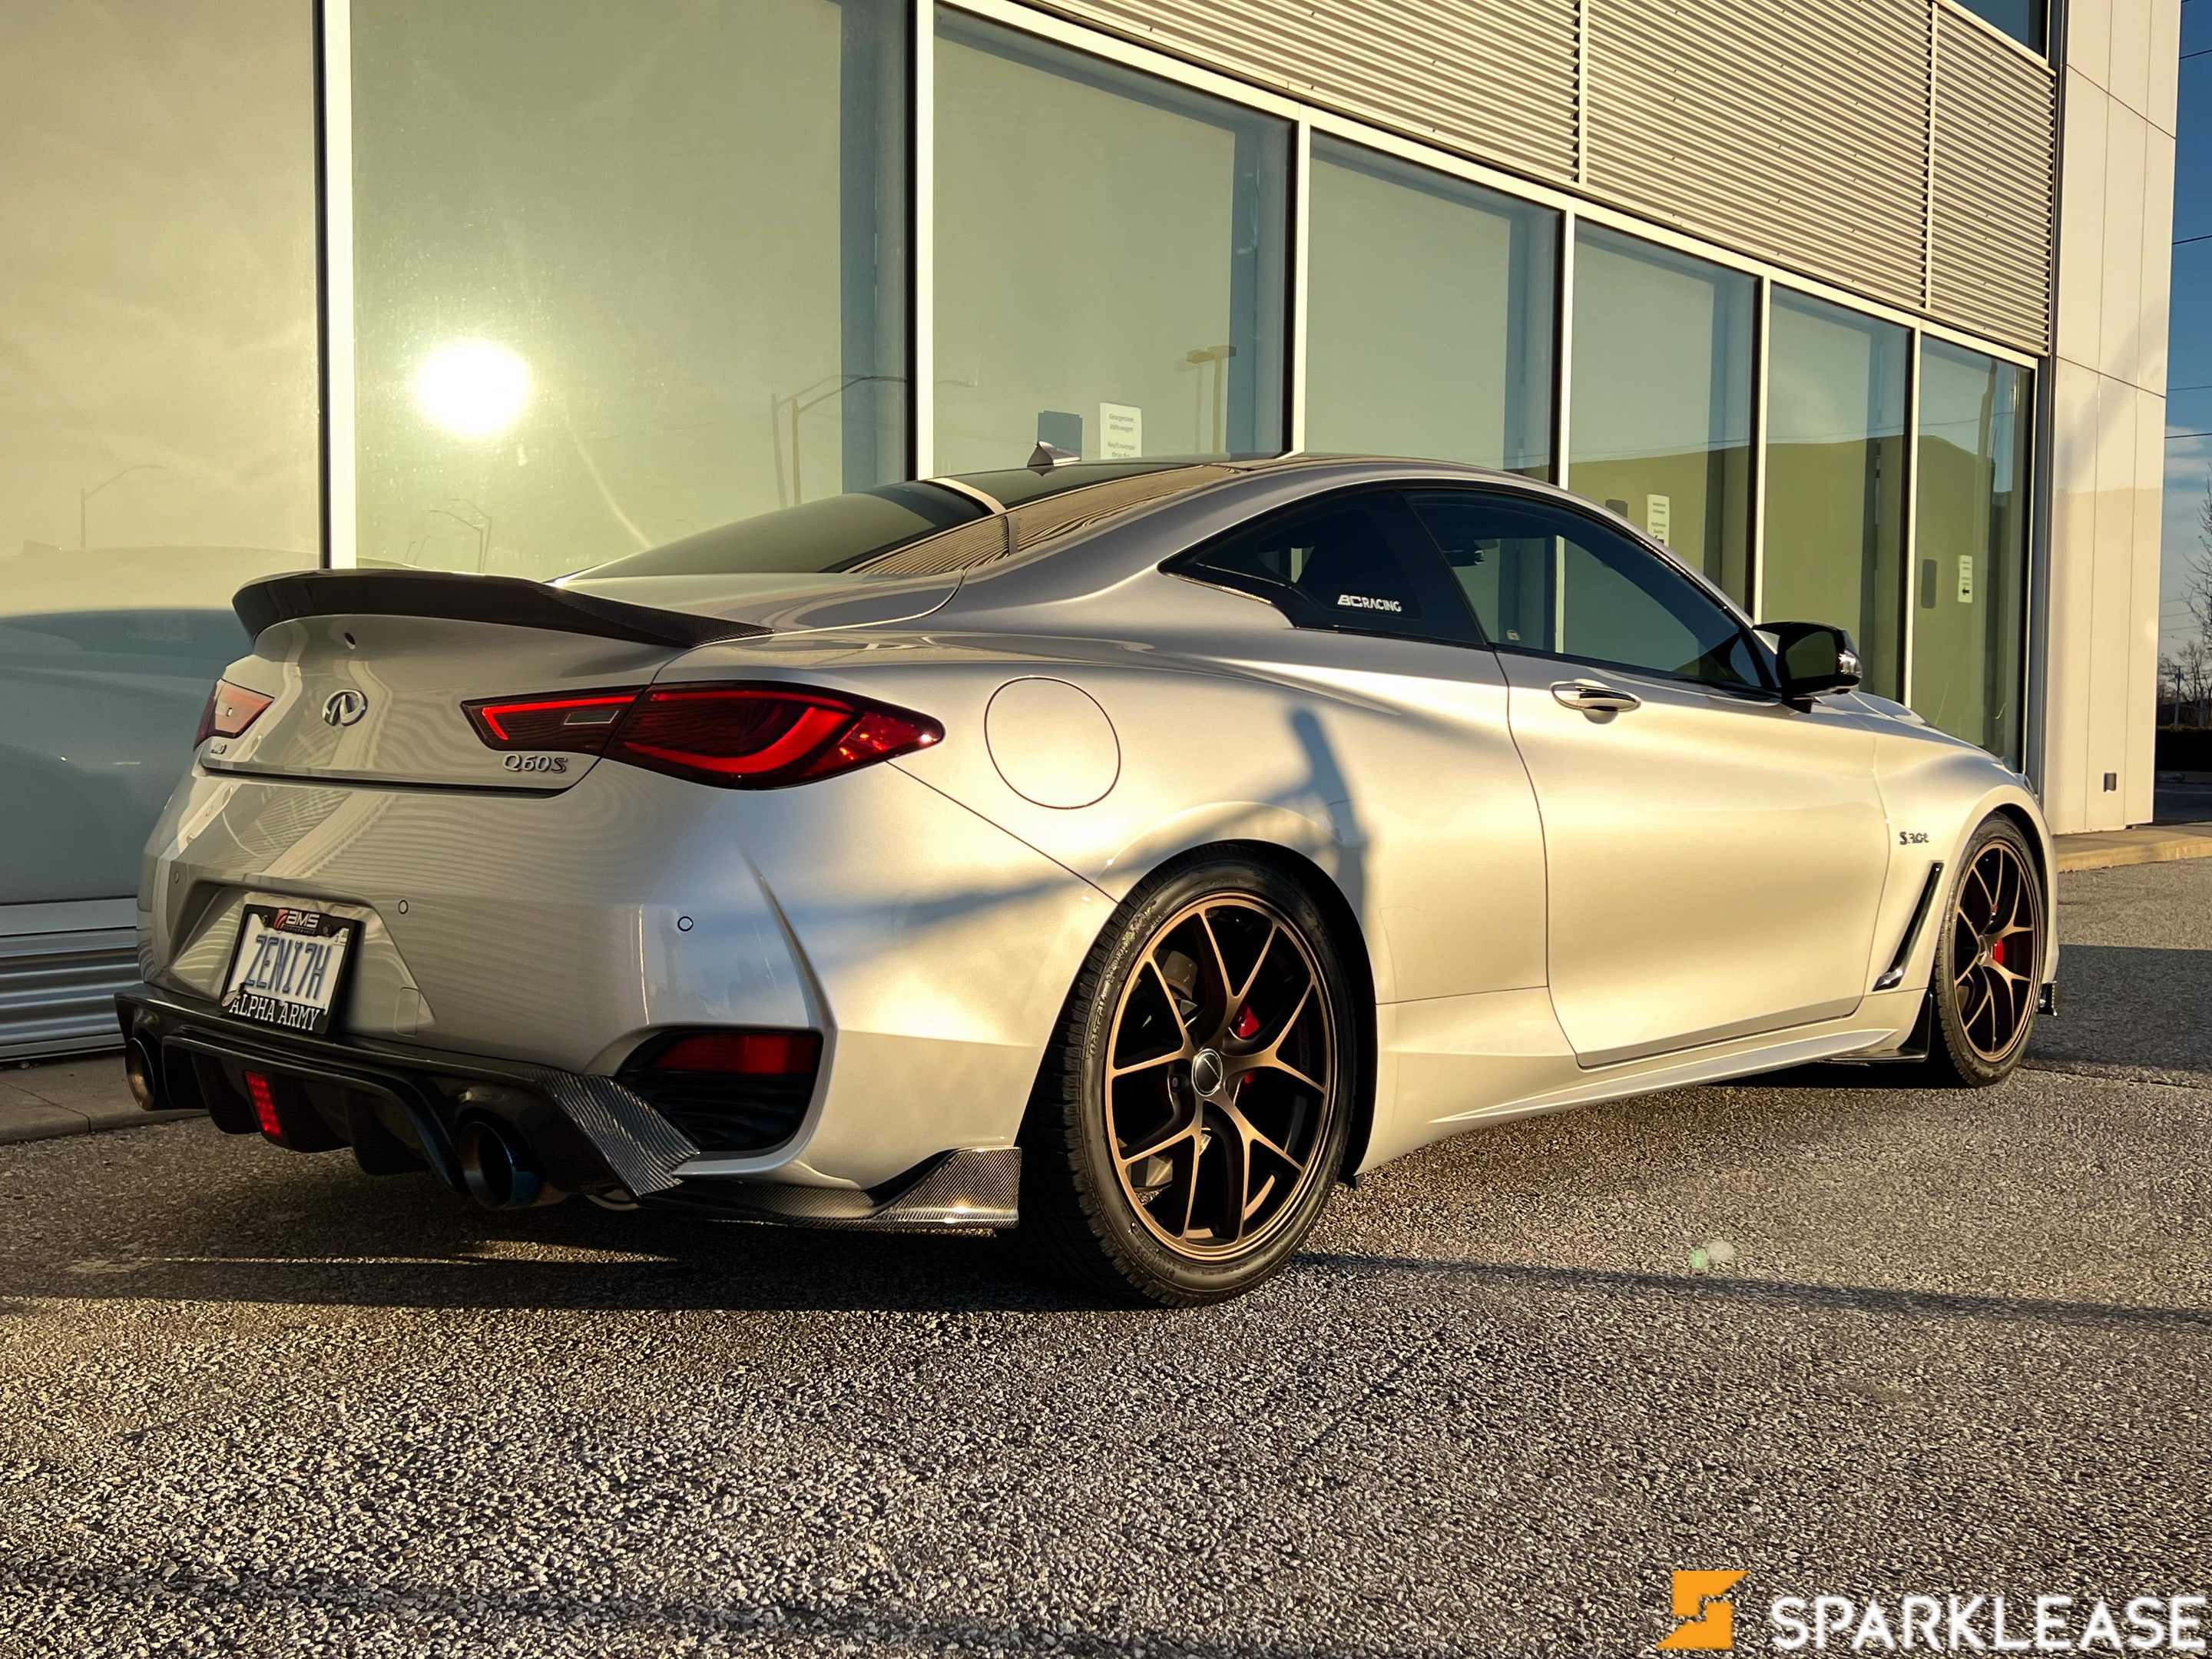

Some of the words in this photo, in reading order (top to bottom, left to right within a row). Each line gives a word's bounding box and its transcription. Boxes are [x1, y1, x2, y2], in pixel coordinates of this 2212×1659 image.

[503, 753, 568, 773] Q60S
[229, 994, 275, 1022] ALPHA
[277, 1002, 320, 1031] ARMY
